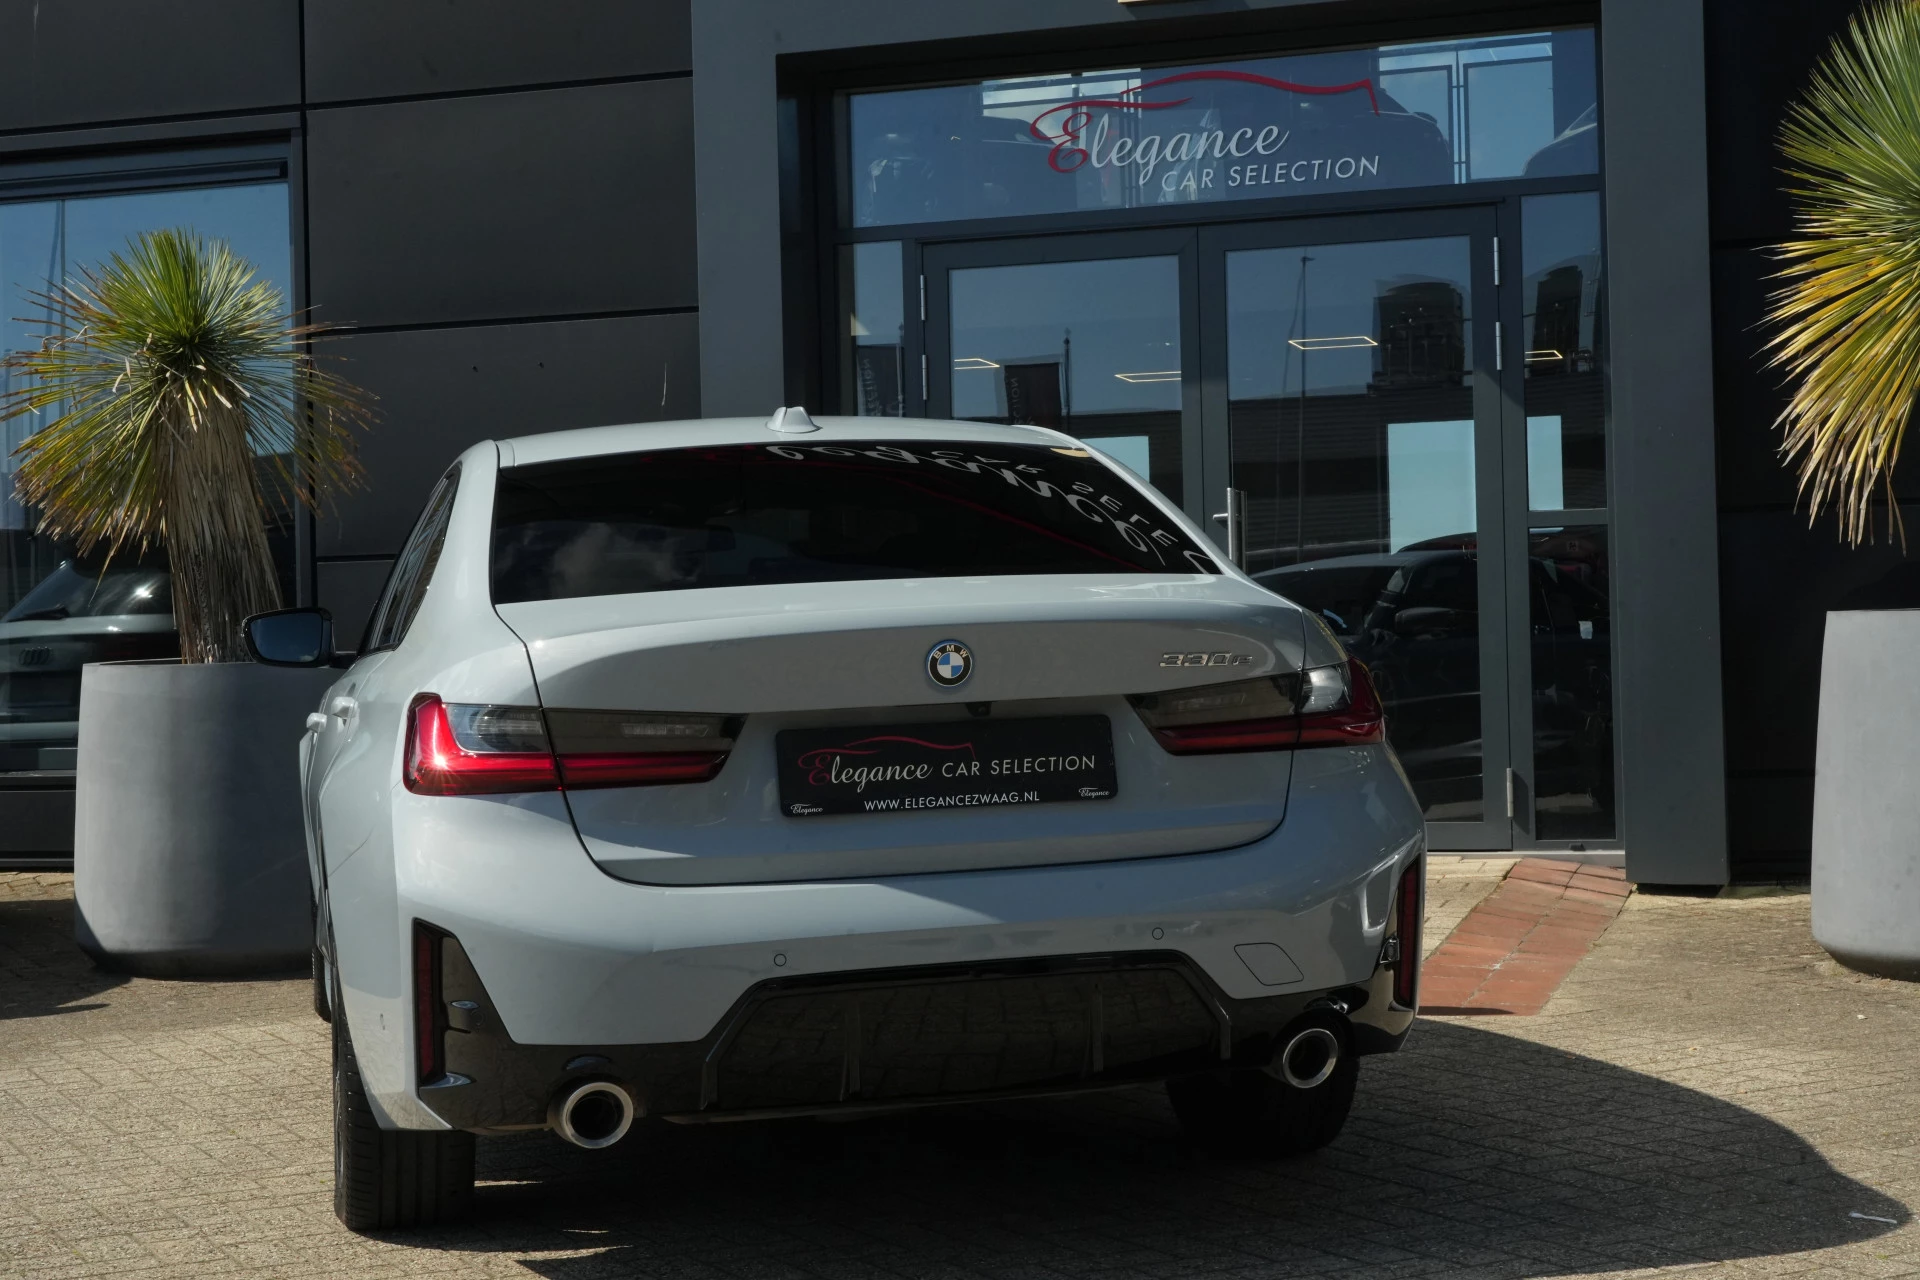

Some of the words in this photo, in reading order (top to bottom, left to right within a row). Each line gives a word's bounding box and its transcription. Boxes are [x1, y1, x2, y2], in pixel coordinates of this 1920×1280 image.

[1030, 97, 1290, 187] Elegance
[1161, 166, 1216, 192] CAR
[1228, 155, 1381, 187] SELECTION
[933, 644, 969, 659] BMW
[798, 748, 934, 794] Elegance
[942, 761, 981, 778] CAR
[990, 755, 1096, 775] SELECTION
[864, 791, 1040, 811] WWW.ELEGANCEZWAAG.NL
[1078, 787, 1110, 799] Elegance
[790, 803, 824, 816] Elegance
